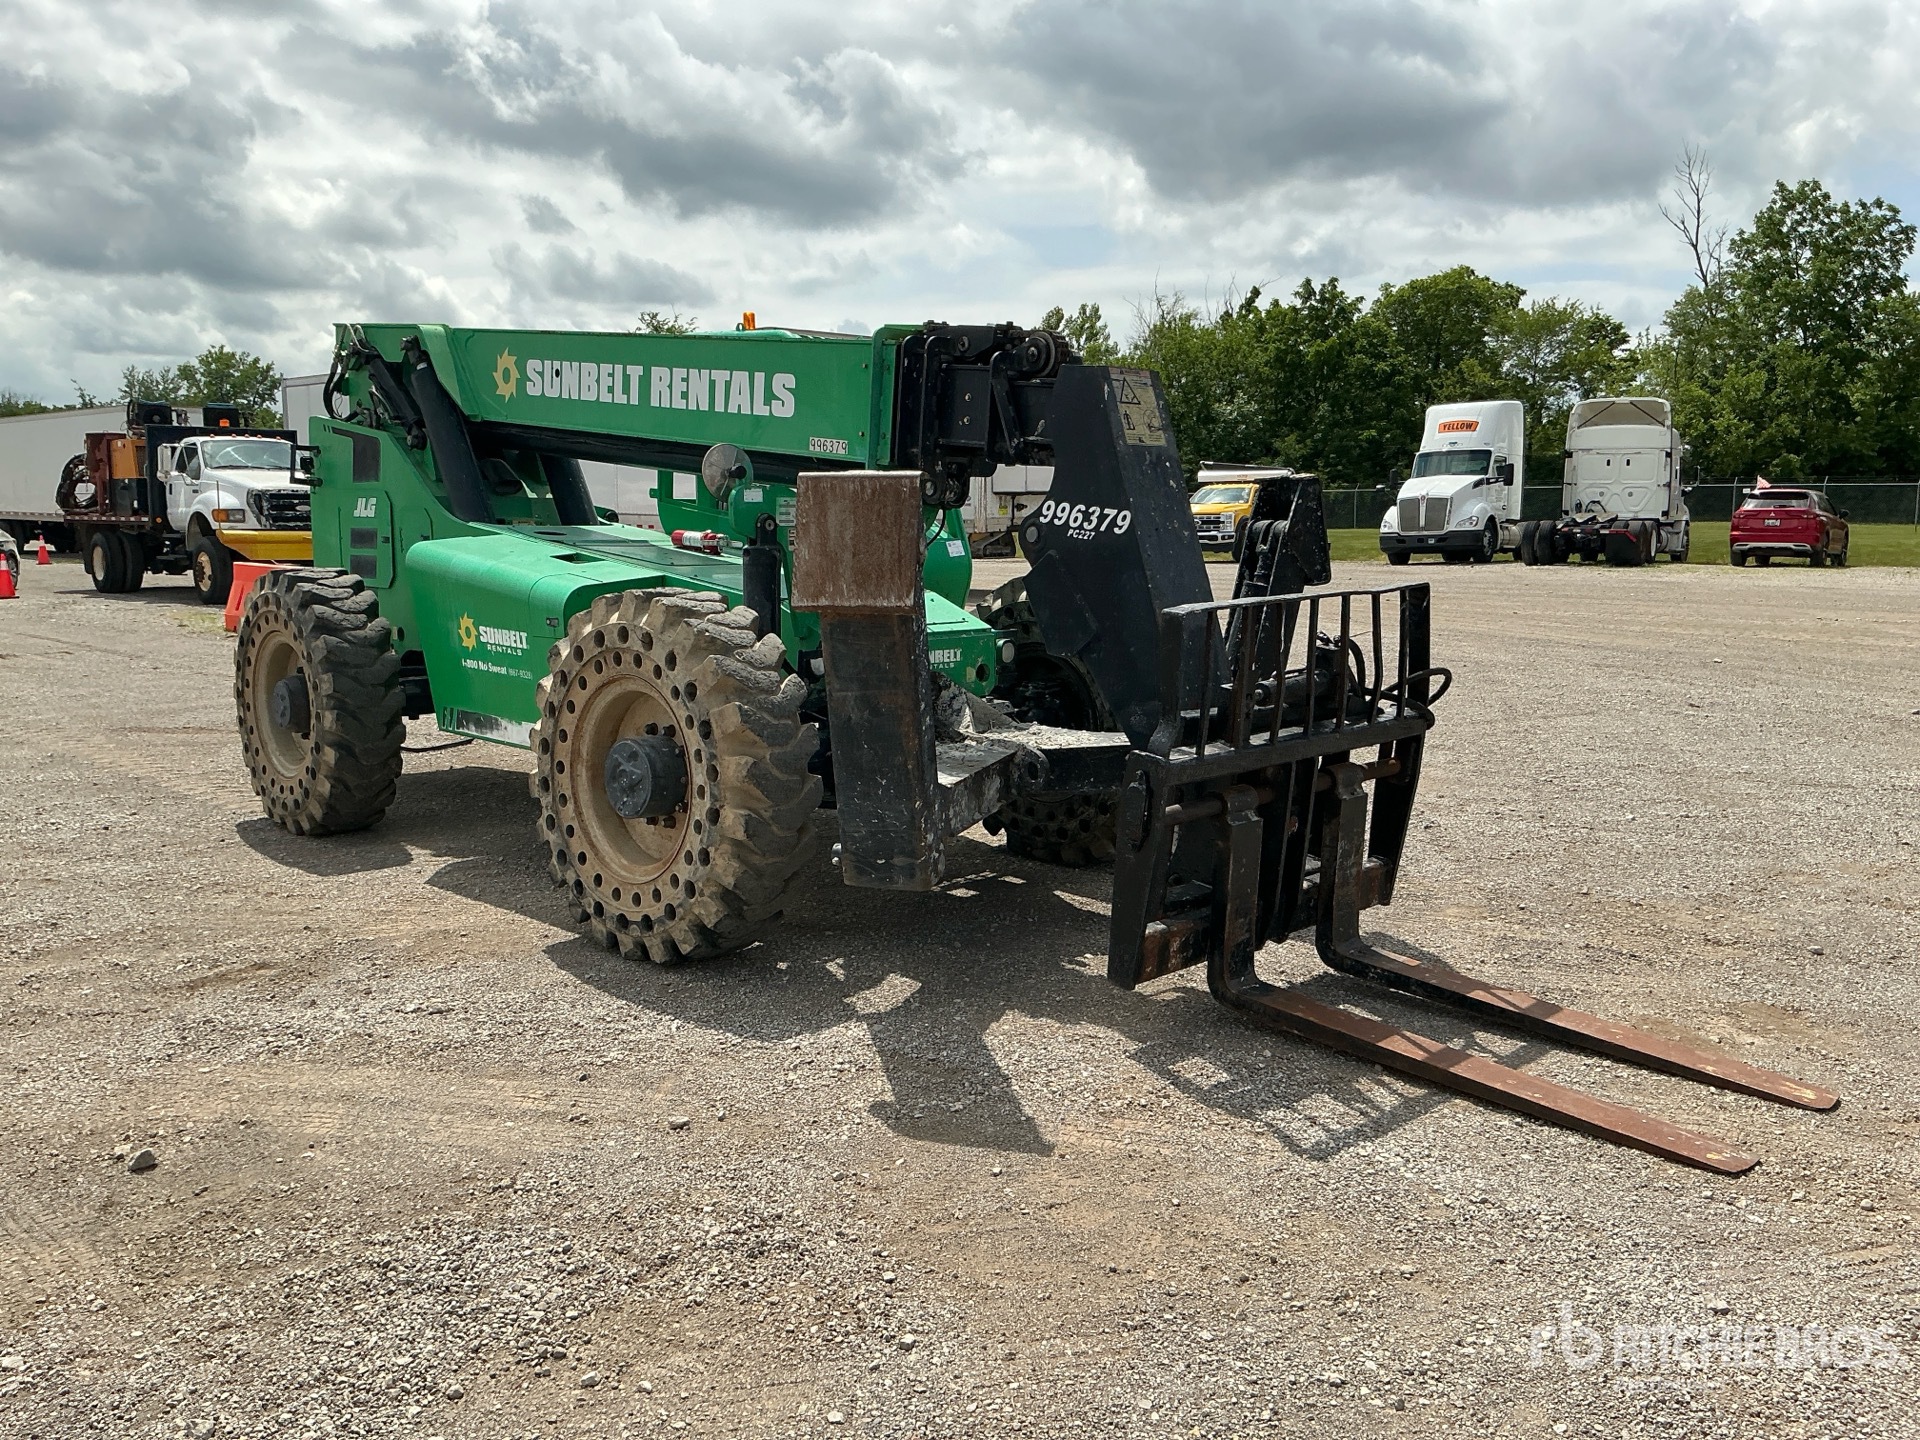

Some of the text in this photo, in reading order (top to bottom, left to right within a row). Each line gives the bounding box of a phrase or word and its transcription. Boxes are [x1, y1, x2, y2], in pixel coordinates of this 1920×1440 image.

[526, 359, 796, 418] SUNBELT RENTALS
[1443, 422, 1474, 431] YELLOW
[811, 438, 848, 455] 996379
[353, 497, 377, 518] JLG
[1040, 500, 1132, 535] 996379
[1067, 529, 1096, 540] PC227
[479, 625, 528, 649] SUNBELT
[487, 644, 522, 656] RENTALS
[928, 648, 962, 664] NBELT
[462, 658, 478, 669] 1-800
[479, 660, 488, 671] No
[488, 662, 507, 675] Sweat
[930, 662, 955, 670] TALS
